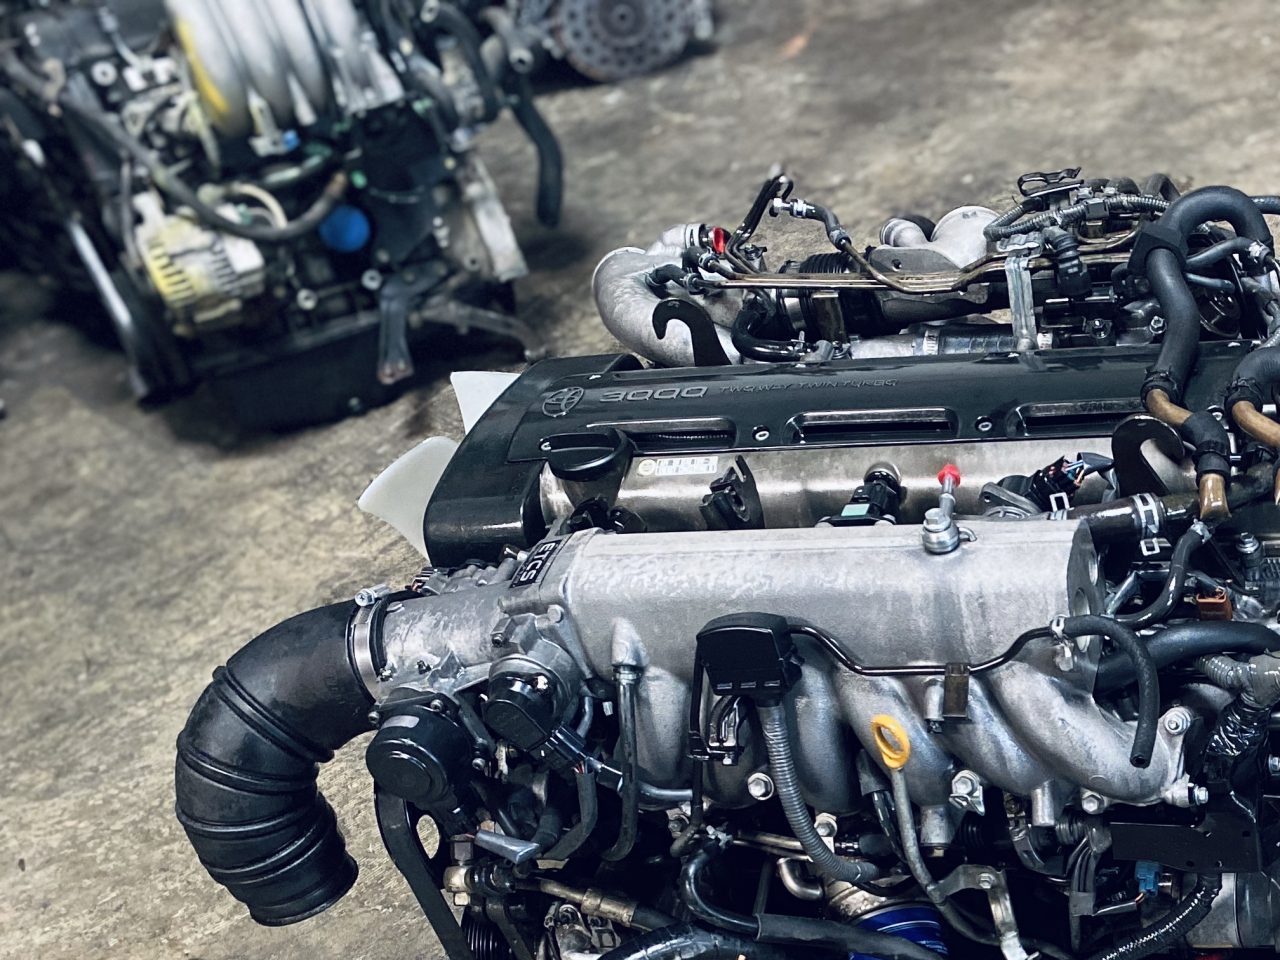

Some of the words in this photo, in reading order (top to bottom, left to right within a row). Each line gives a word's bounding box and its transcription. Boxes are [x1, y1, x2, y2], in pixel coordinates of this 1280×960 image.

[600, 386, 708, 402] 3000
[799, 380, 839, 389] TWIN
[519, 542, 556, 581] ETCS
